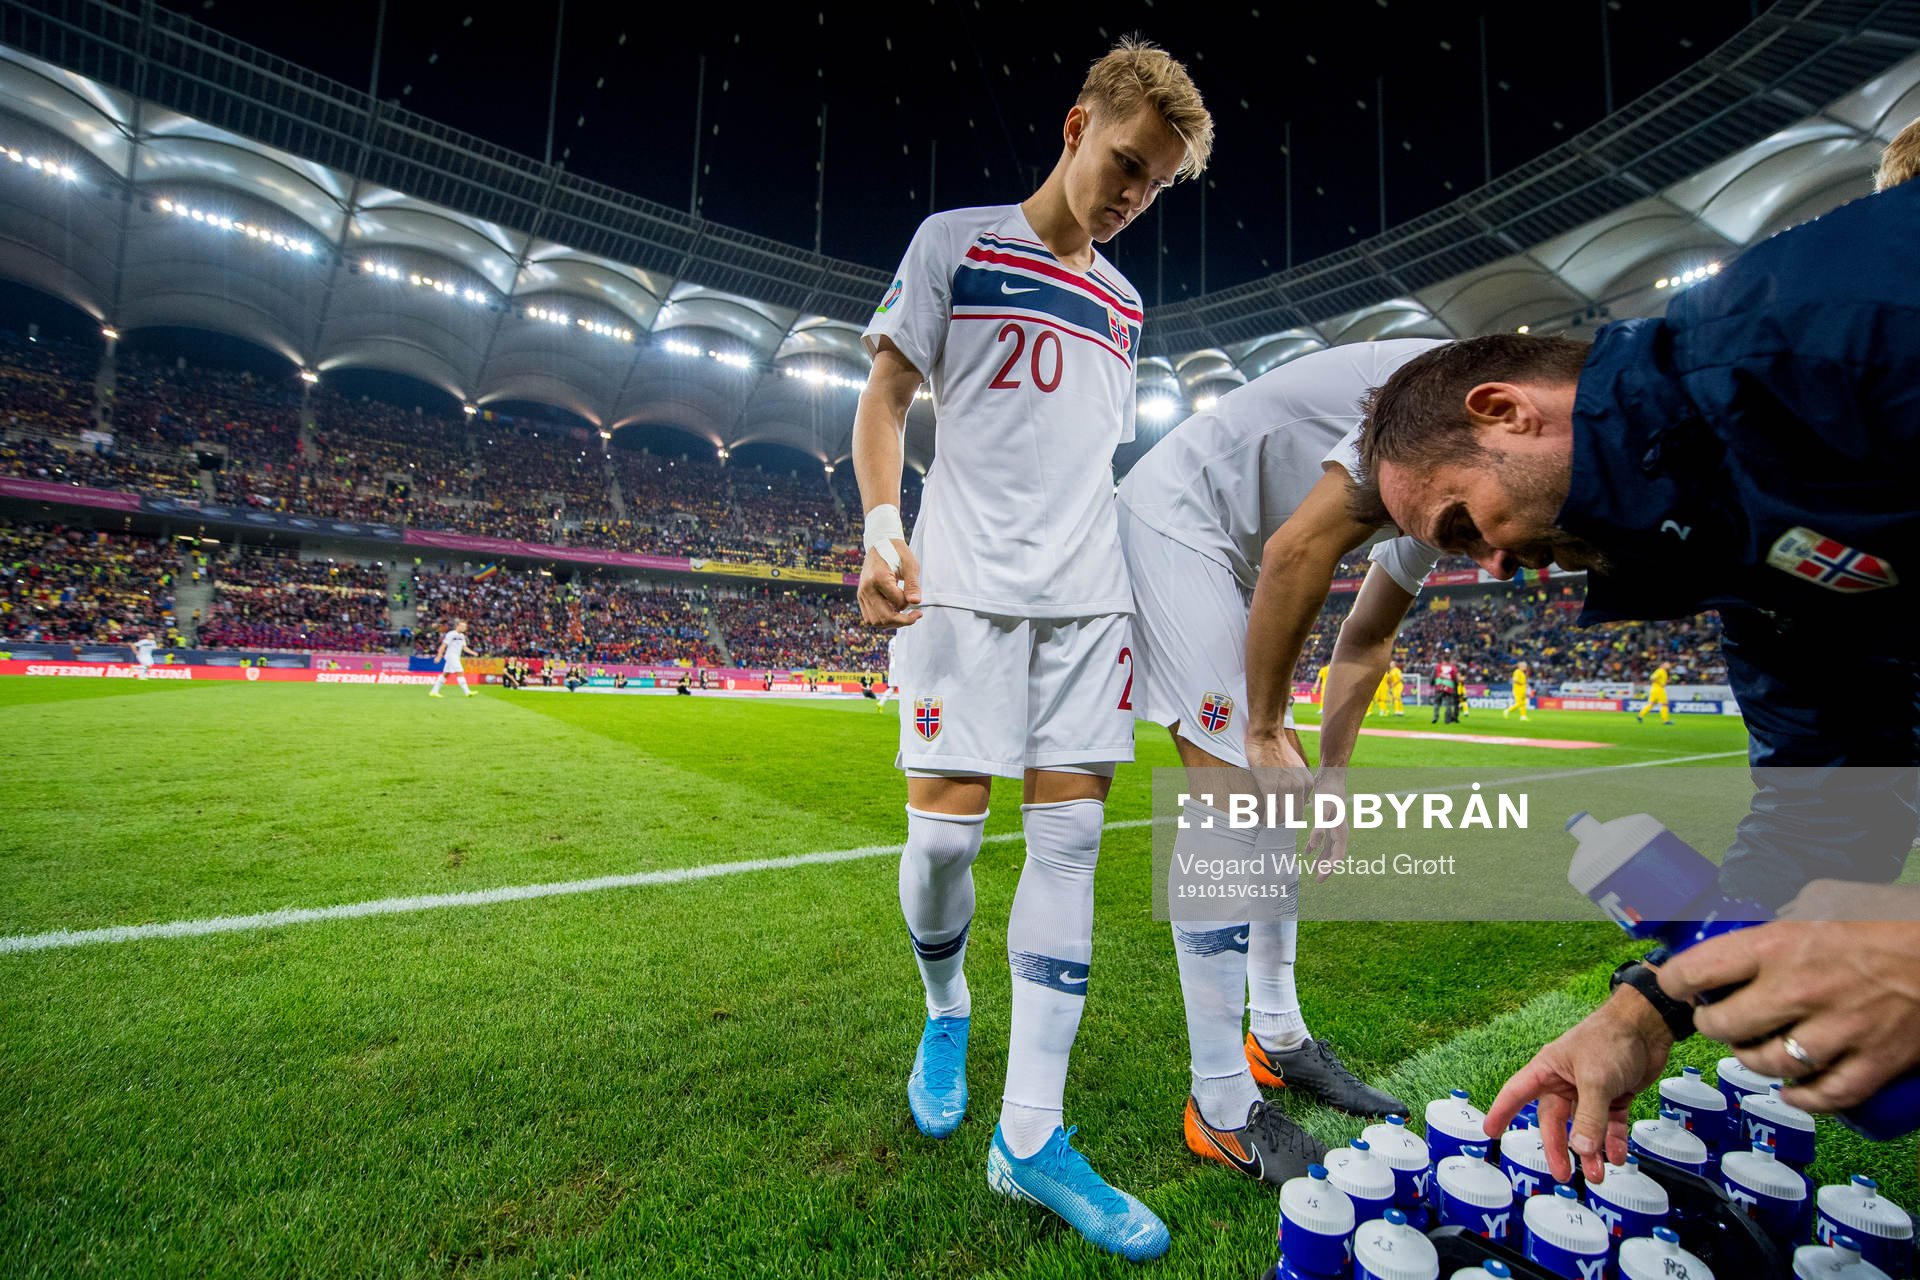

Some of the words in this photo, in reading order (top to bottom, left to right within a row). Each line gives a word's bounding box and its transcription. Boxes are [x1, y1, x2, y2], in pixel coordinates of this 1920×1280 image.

[988, 323, 1063, 393] 20
[105, 664, 192, 679] ÎMPEUNĂ
[1507, 1165, 1540, 1198] YT
[1481, 1210, 1510, 1239] YT
[1589, 1198, 1622, 1235] YT
